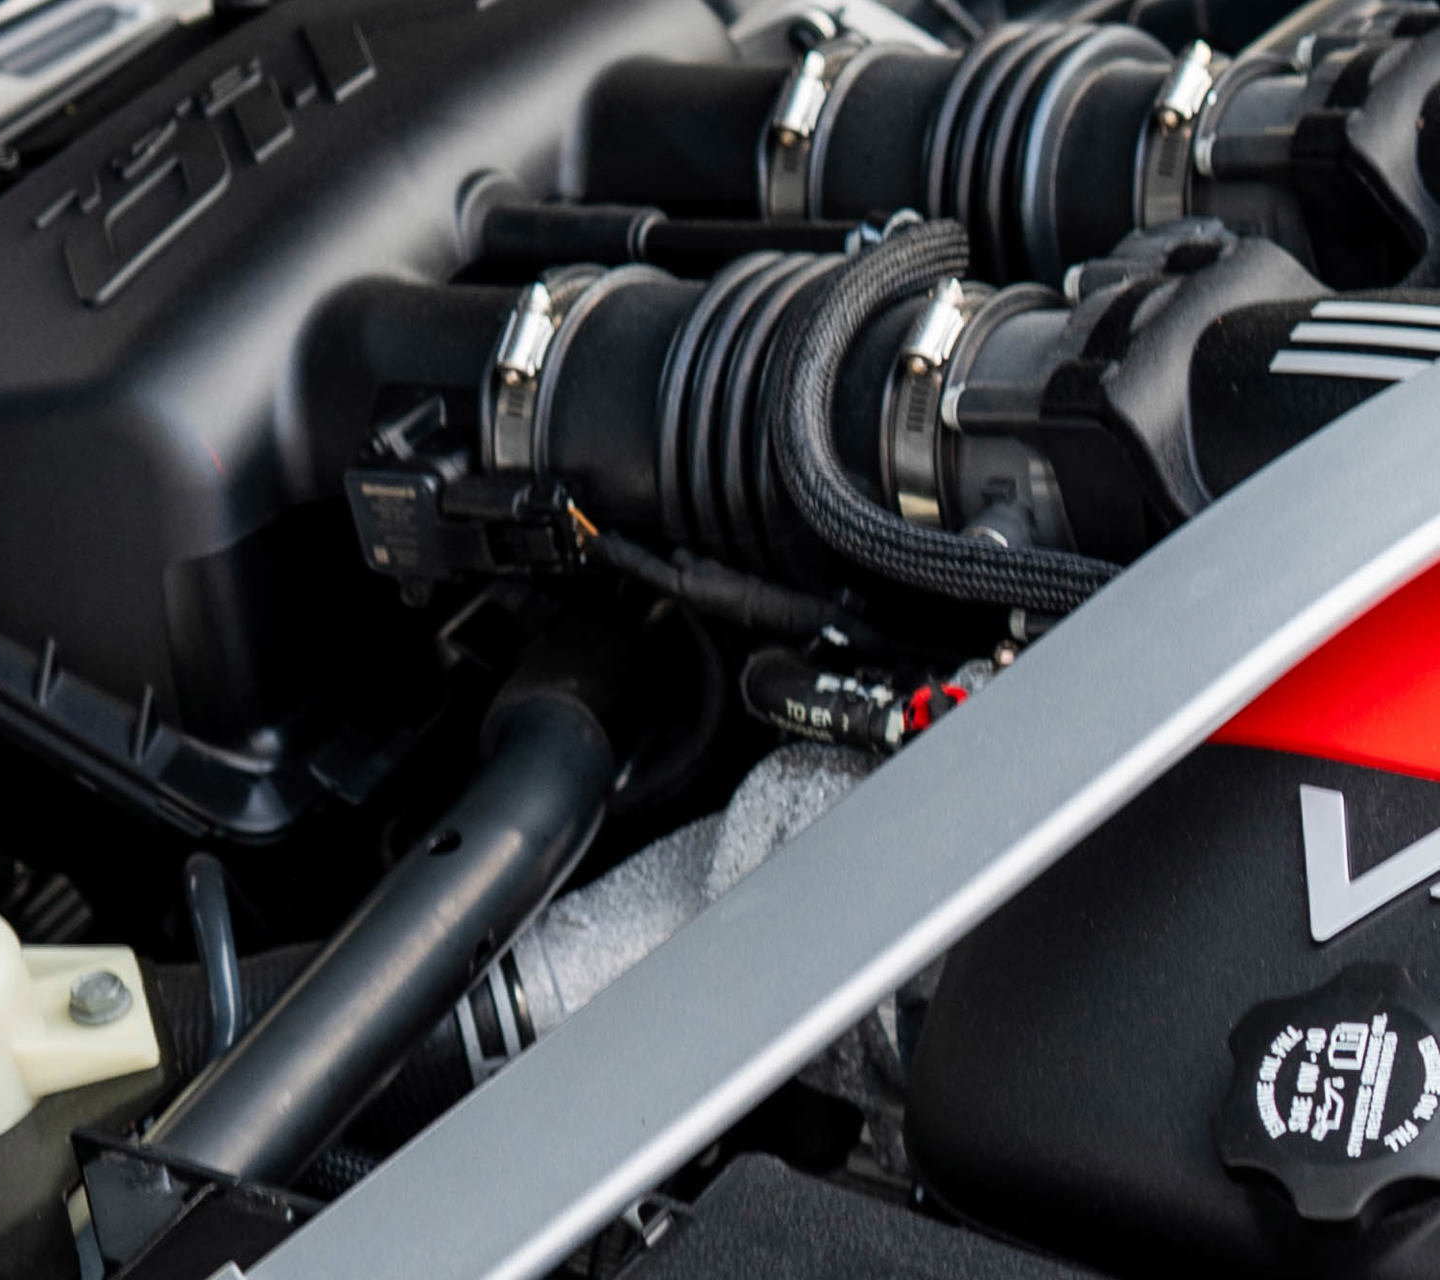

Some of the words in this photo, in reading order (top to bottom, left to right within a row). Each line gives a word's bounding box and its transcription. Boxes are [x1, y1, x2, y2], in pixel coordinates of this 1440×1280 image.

[1270, 1024, 1304, 1060] FILL
[1259, 1055, 1282, 1083] OIL
[1256, 1080, 1287, 1139] ENGINE
[1287, 1095, 1313, 1134] SAE
[1413, 1093, 1439, 1121] OIL
[1383, 1118, 1420, 1154] FILL
